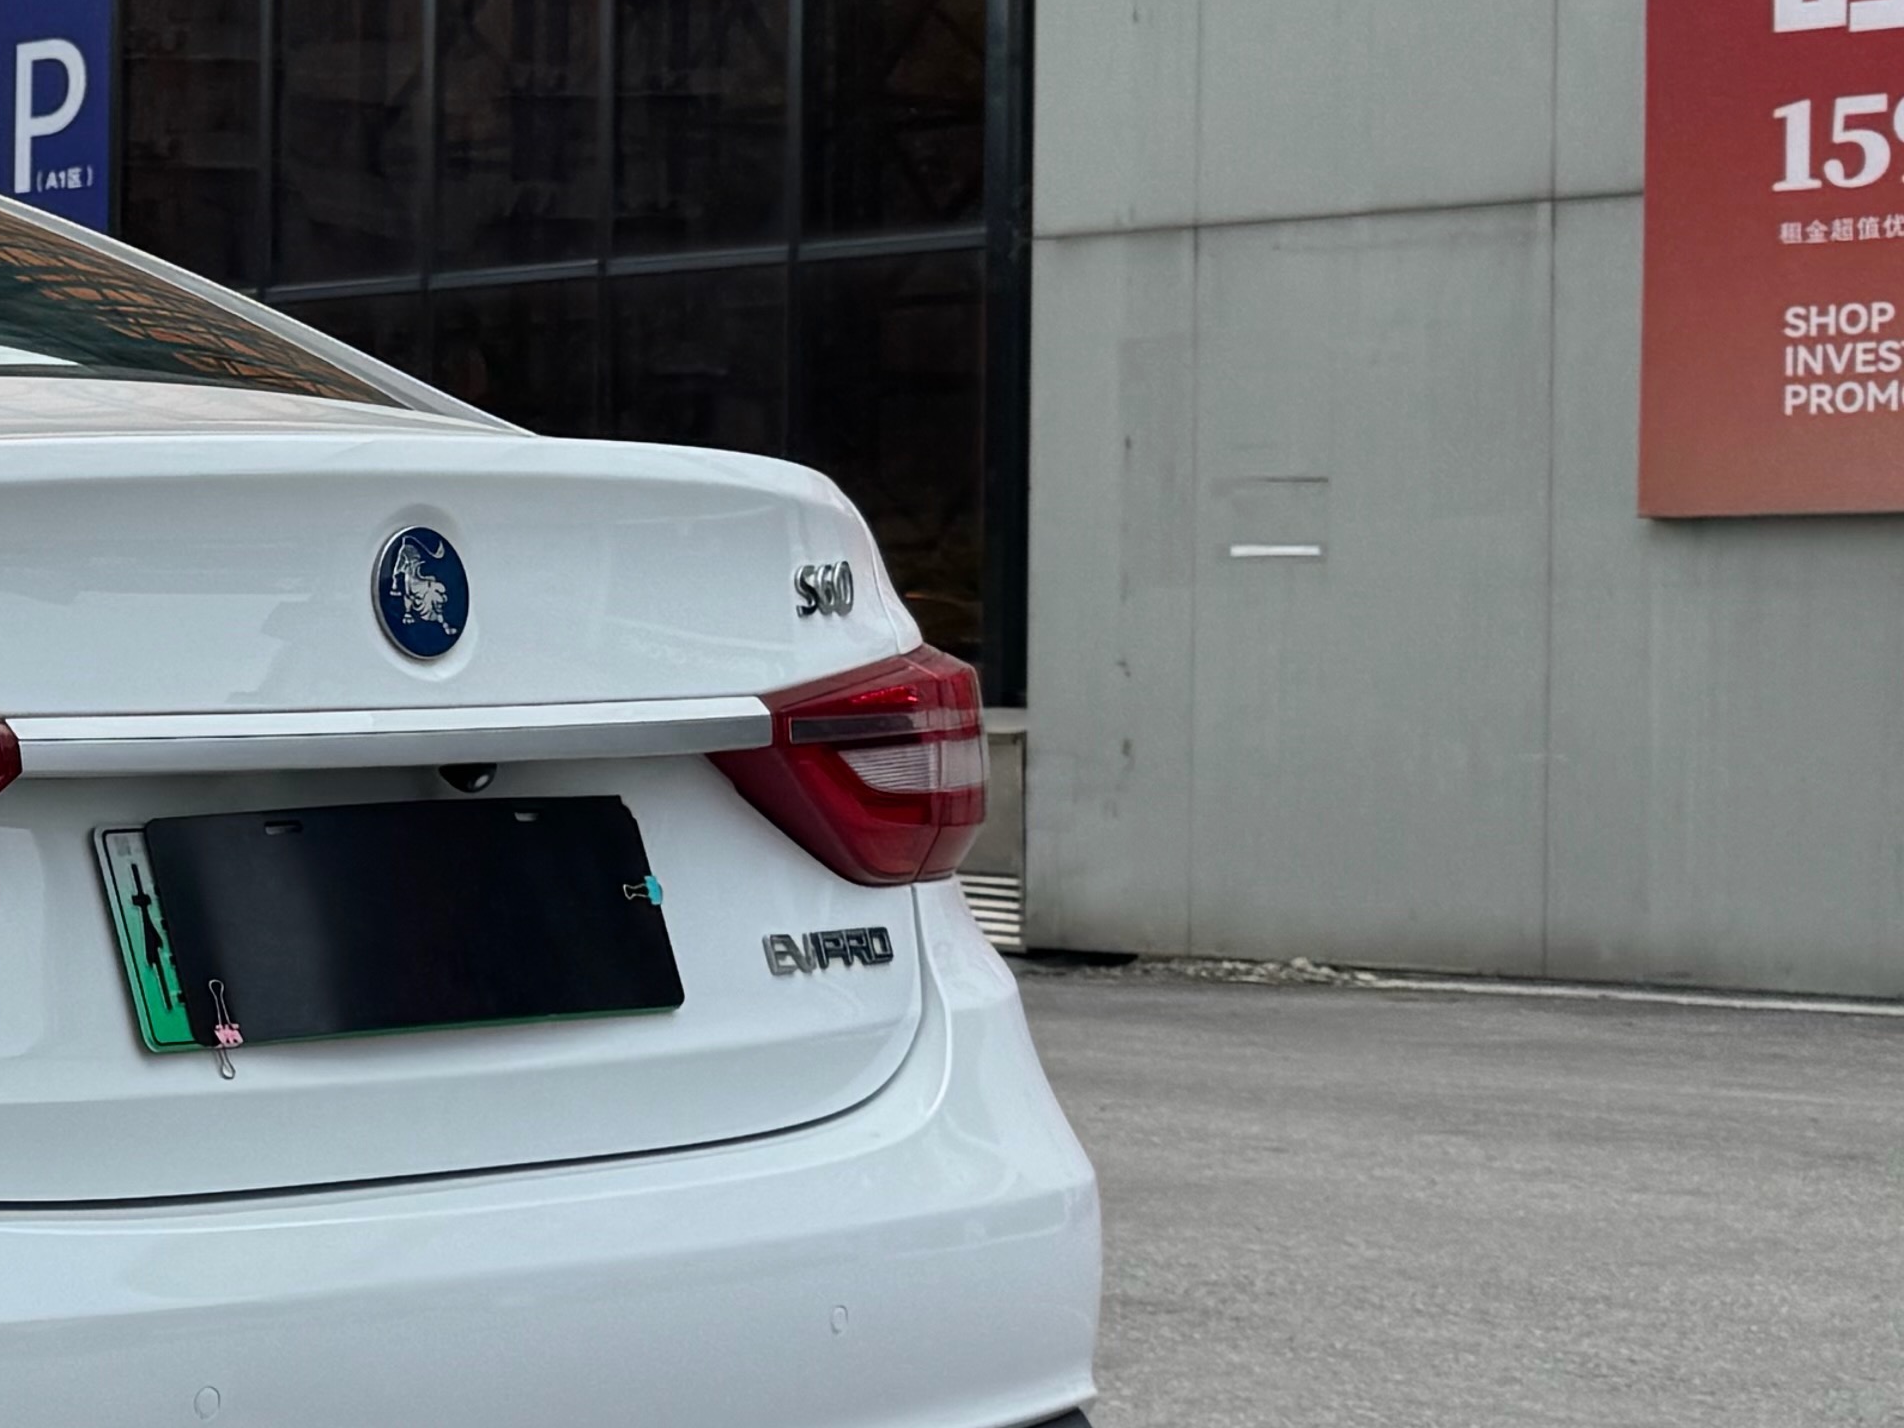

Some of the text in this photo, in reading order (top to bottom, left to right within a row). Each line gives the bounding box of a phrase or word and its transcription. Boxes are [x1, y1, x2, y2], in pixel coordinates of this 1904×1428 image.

[14, 38, 87, 194] P
[1772, 92, 1904, 192] 15
[1783, 301, 1896, 338] SHOP
[1784, 339, 1904, 377] INVES
[1784, 379, 1904, 416] PROM
[794, 560, 854, 618] S60
